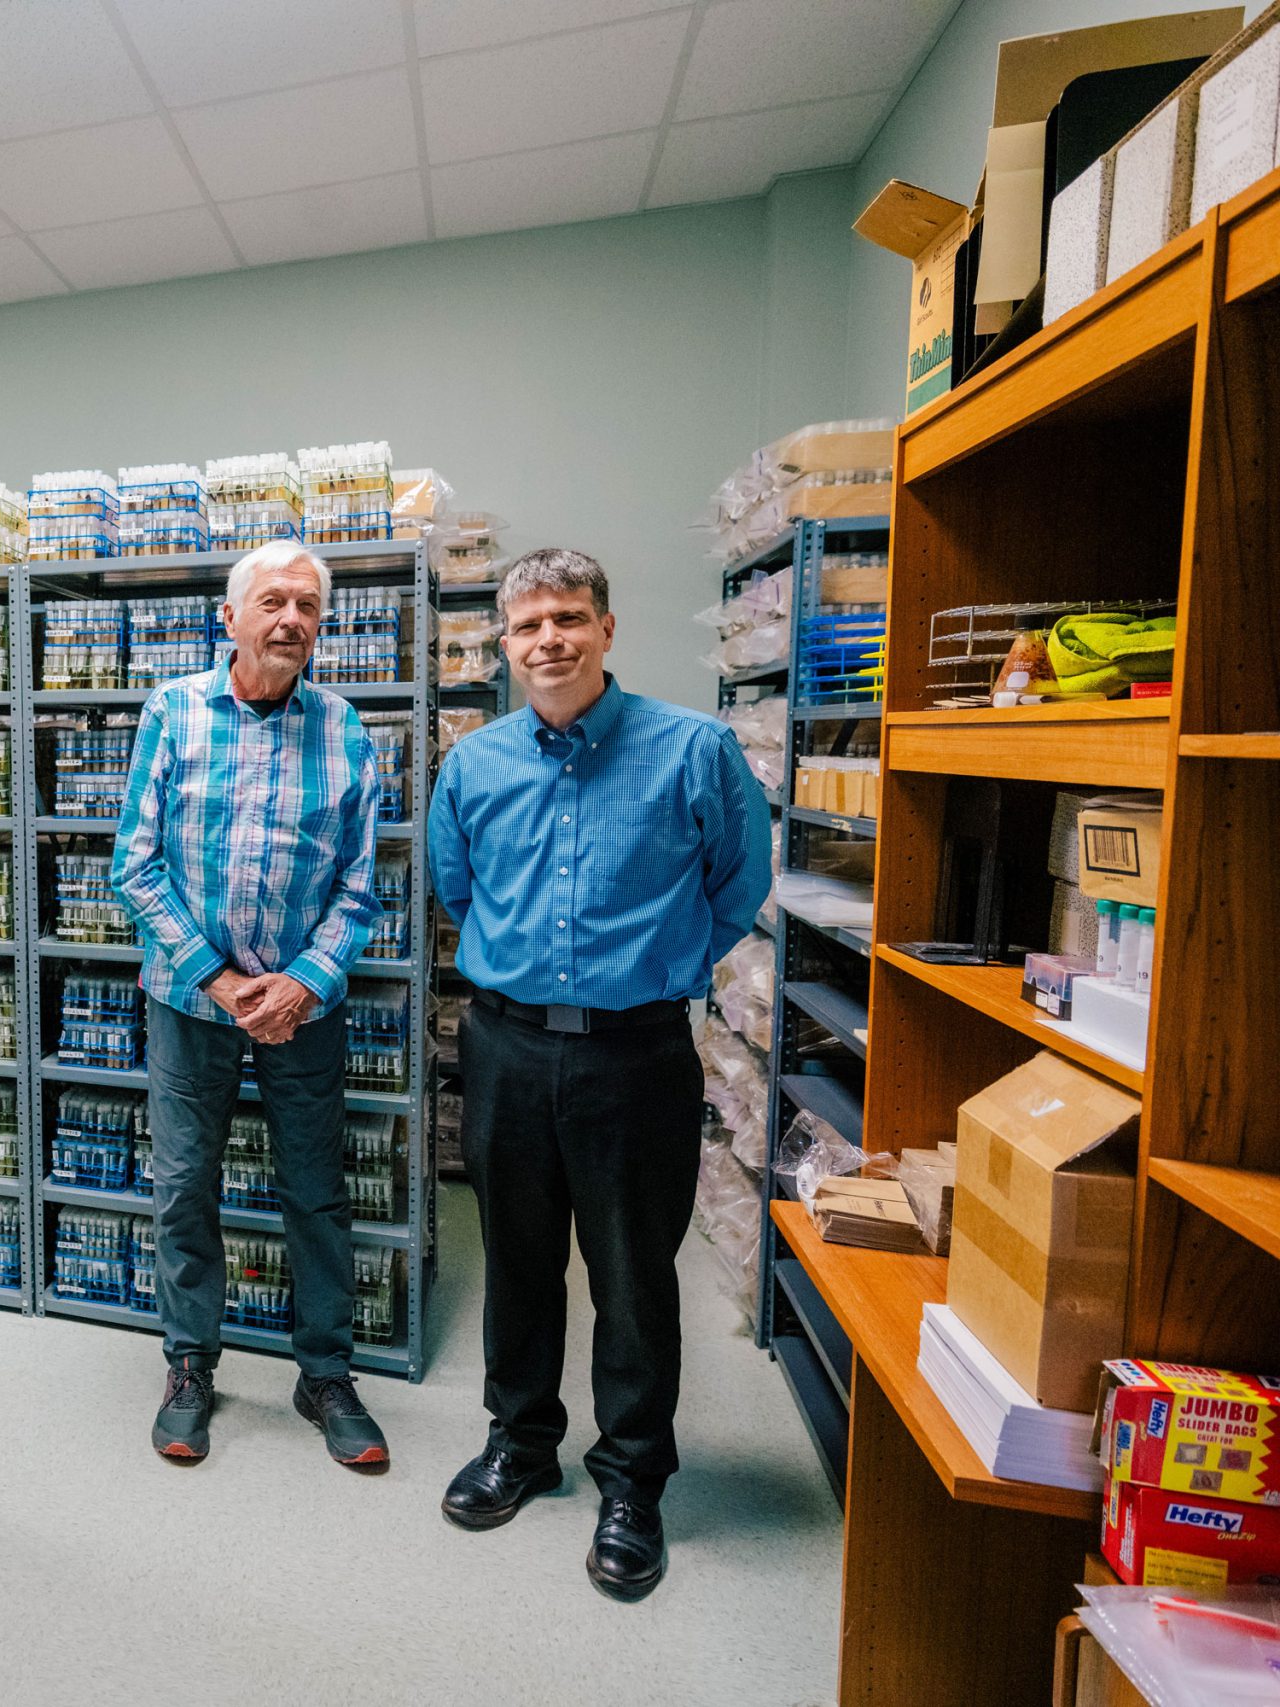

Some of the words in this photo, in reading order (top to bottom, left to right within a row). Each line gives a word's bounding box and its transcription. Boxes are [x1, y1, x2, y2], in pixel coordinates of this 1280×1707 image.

[1138, 971, 1149, 980] 19
[1155, 1362, 1222, 1378] JUMBO
[1147, 1401, 1166, 1436] Hefty
[1180, 1397, 1260, 1424] JUMBO
[1178, 1418, 1220, 1433] SLIDER
[1225, 1424, 1258, 1438] BAGS
[1197, 1434, 1218, 1443] GREAT
[1170, 1505, 1239, 1533] Hefty
[1217, 1530, 1257, 1542] OneZip
